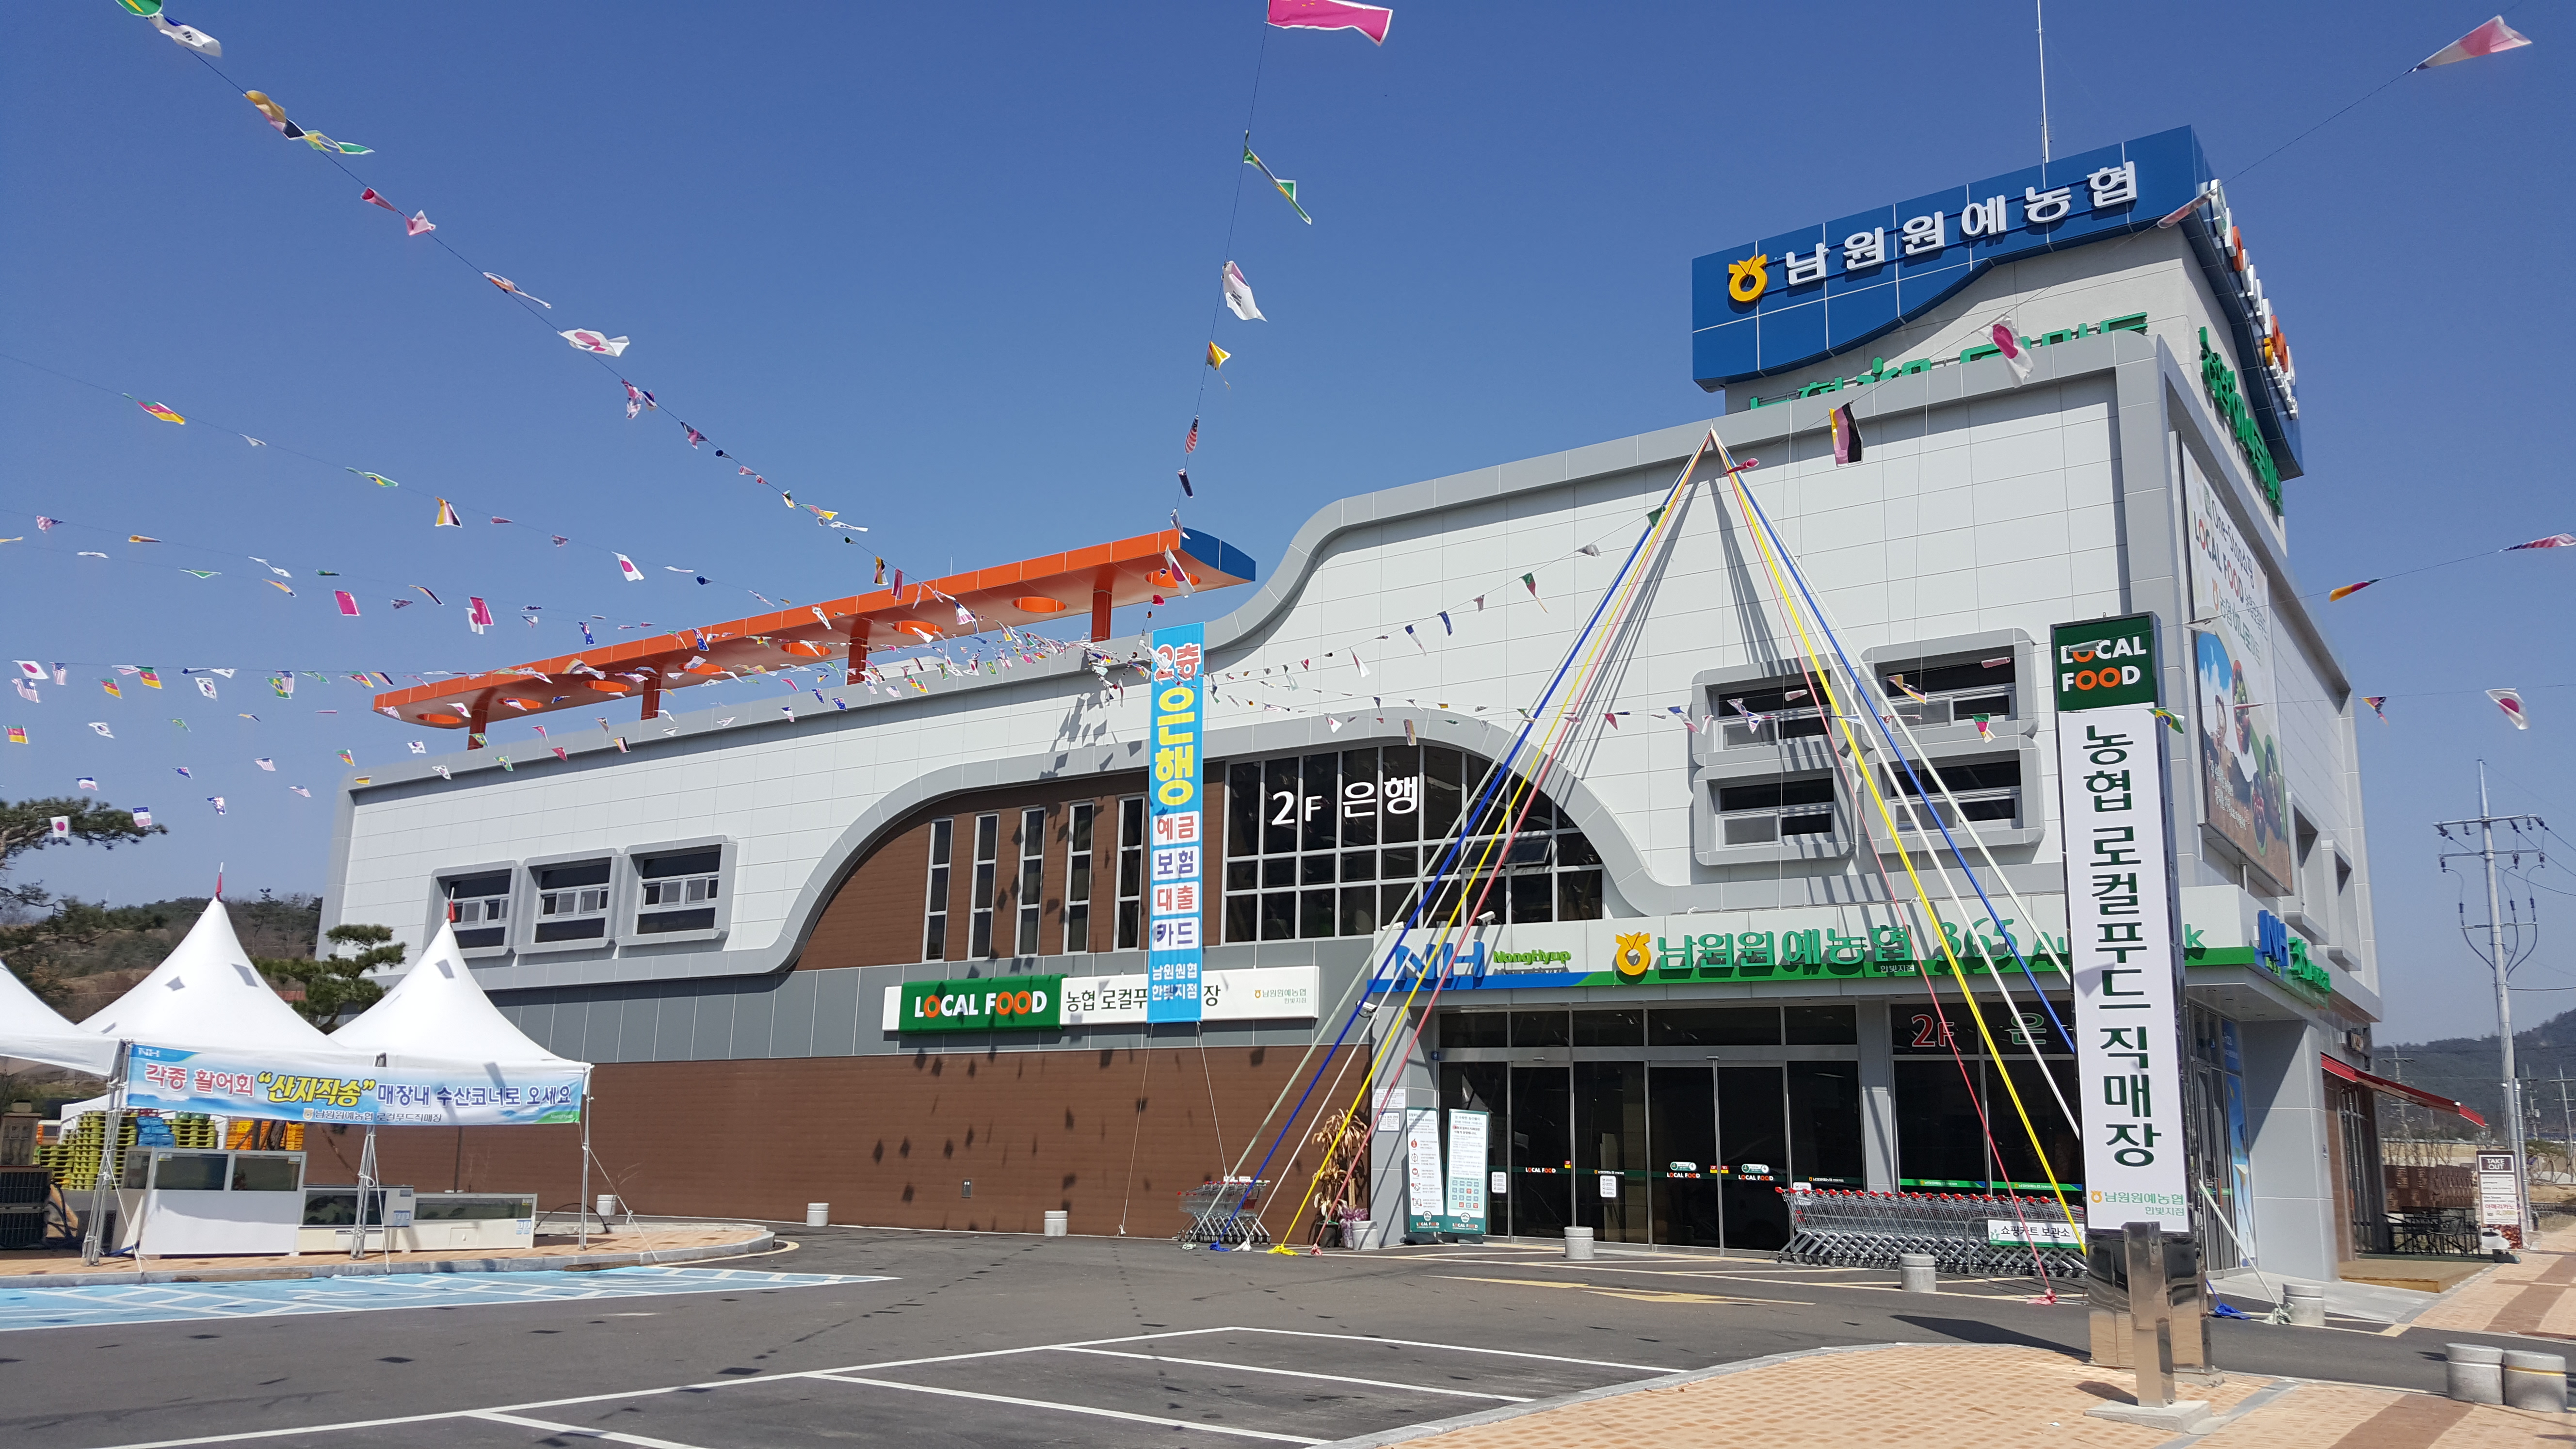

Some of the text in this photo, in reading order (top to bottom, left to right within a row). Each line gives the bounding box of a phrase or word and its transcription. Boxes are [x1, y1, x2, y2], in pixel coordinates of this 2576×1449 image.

[1785, 161, 2137, 286] 남원원예농협
[2193, 511, 2222, 573] LOCAL
[2222, 551, 2244, 604] FOOD
[2061, 636, 2146, 664] LOCAL
[2062, 665, 2141, 692] FOOD
[1155, 687, 1195, 806] 은행
[1272, 776, 1418, 825] 2F 은행
[1157, 815, 1194, 840] 예금
[1157, 850, 1194, 875] 보험
[1157, 886, 1193, 911] 대출
[1156, 922, 1193, 946] 카드
[1657, 924, 1914, 970] 남원원예농협
[1936, 917, 2018, 961] 365
[1152, 962, 1198, 981] 남원원협
[1395, 941, 1571, 981] NH NongHyup
[1880, 963, 1915, 973] 한빛지점
[914, 987, 1147, 1018] LOCAL FOOD 농협 로컬푸
[1152, 983, 1198, 1000] 한빛지점
[1262, 988, 1306, 998] 남원원예농협
[1911, 1014, 1955, 1047] 2F
[138, 1047, 160, 1058] NH
[145, 1063, 187, 1090] 각종
[193, 1068, 255, 1097] 활어회
[377, 1083, 431, 1107] 매장내
[436, 1086, 521, 1107] 수산코너로
[526, 1085, 571, 1106] 오세요
[315, 1111, 373, 1121] 남원원예농협
[2104, 1191, 2184, 1205] 남원원예농협
[2145, 1206, 2185, 1216] 한빛지점
[2000, 1225, 2071, 1239] 쇼핑카트 보관소
